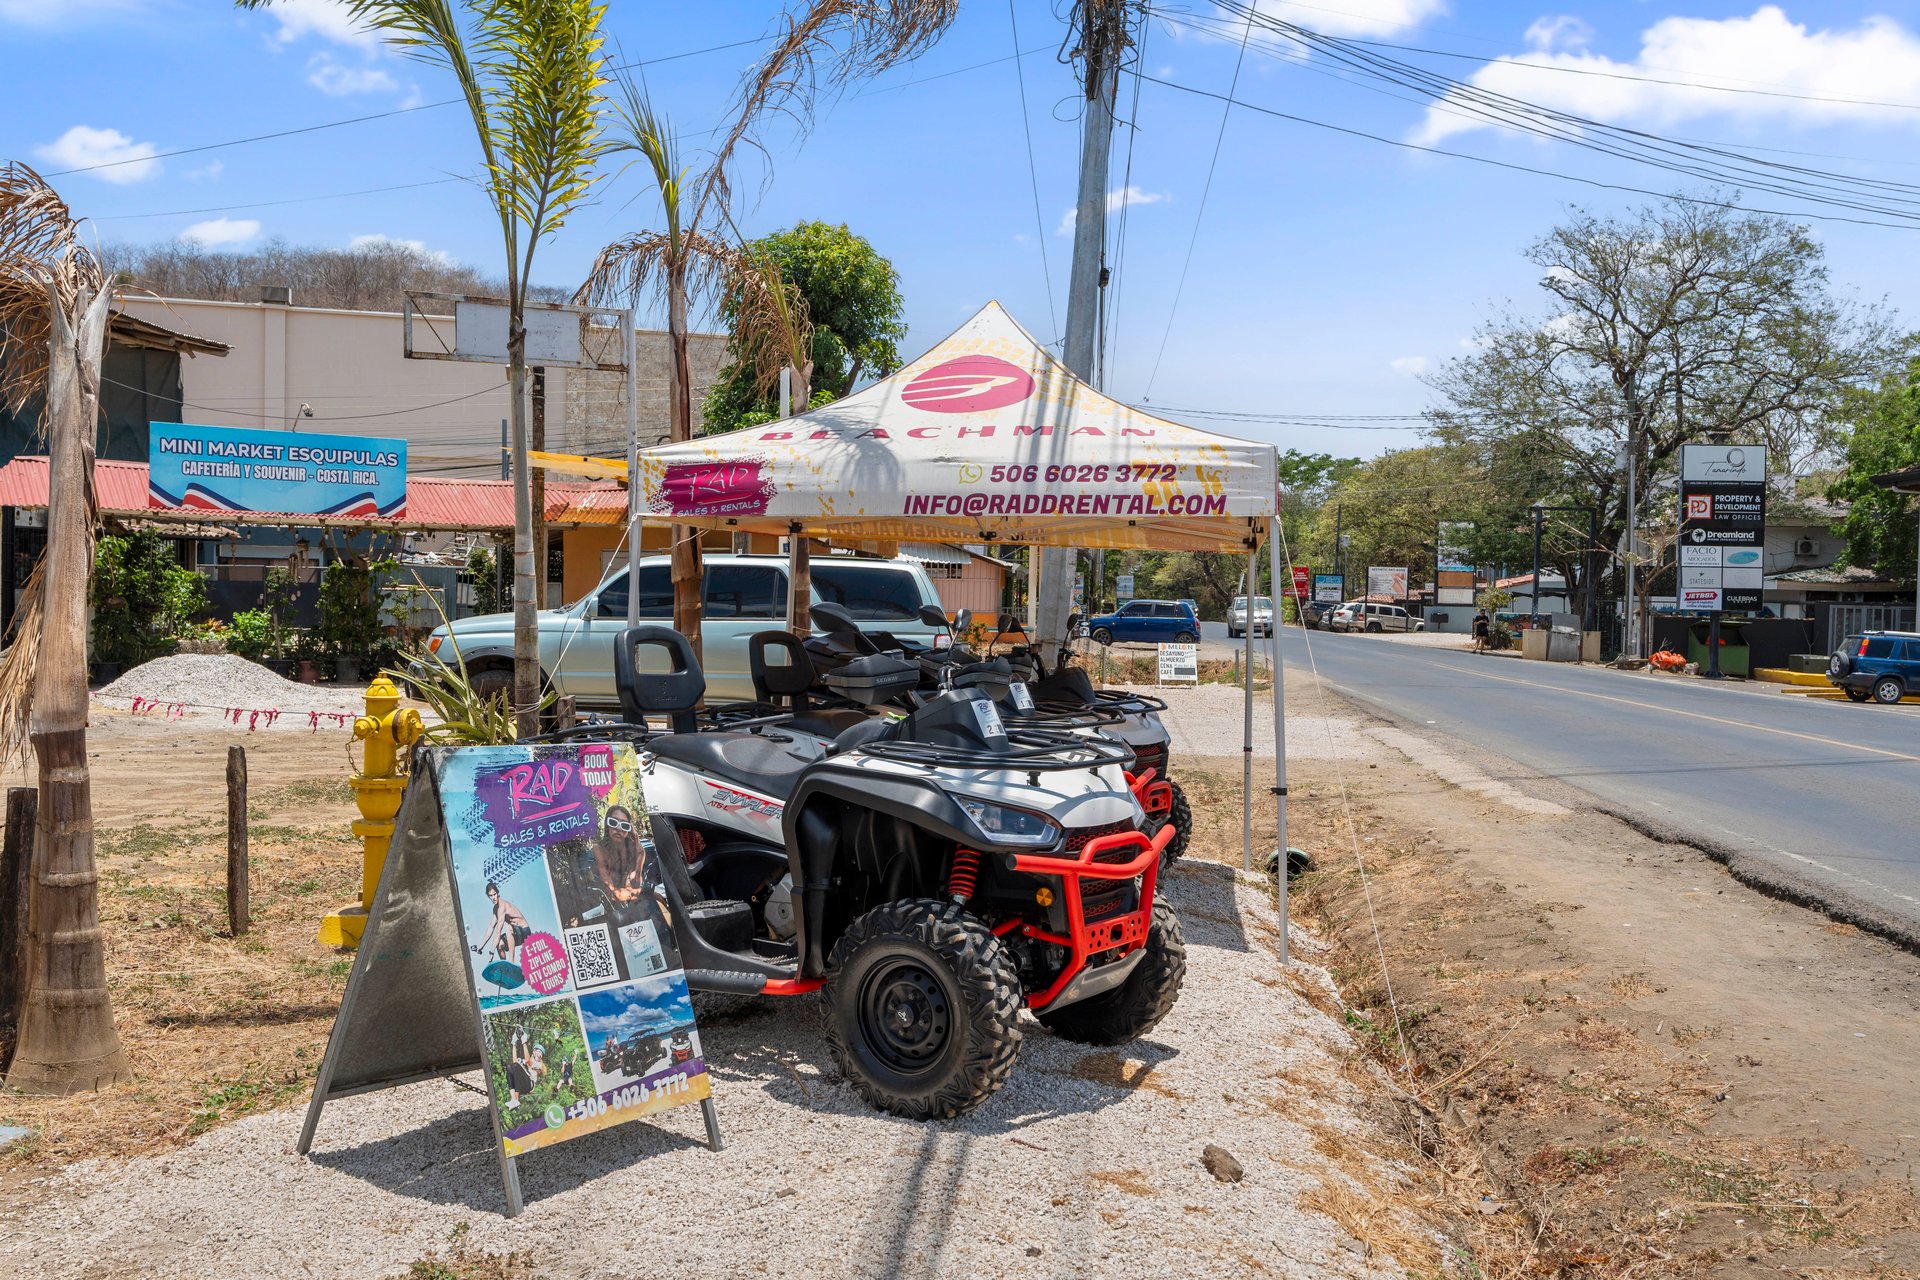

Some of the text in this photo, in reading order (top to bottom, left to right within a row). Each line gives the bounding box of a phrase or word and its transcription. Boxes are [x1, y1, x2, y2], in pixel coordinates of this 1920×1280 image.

[759, 425, 1155, 441] BEACHMAN
[160, 437, 399, 467] MINI MARKET ESQUIPULAS
[182, 460, 240, 478] CAFETERÍA
[243, 464, 251, 478] Y
[254, 465, 306, 482] SOUVENIR
[316, 468, 349, 484] COSTA
[352, 471, 379, 485] RICA.
[684, 463, 754, 501] RAD
[990, 464, 1177, 483] 506 6026 3772
[677, 499, 761, 517] SALES & RENTALS
[904, 493, 1228, 516] INFO@RADDRENTAL.COM
[1715, 495, 1753, 503] PROPERTY
[1686, 547, 1717, 555] FACIO
[876, 676, 898, 684] SEGWAY
[987, 725, 994, 734] 2
[584, 754, 608, 769] BOOK
[583, 770, 612, 786] TODAY
[500, 761, 573, 819] RAD
[500, 812, 590, 849] SALES & RENTALS
[626, 926, 644, 937] RAD
[525, 938, 548, 957] E-FOIL
[528, 949, 554, 970] ZIPLINE
[529, 958, 566, 985] ATV COMBO
[541, 973, 564, 991] TOURS
[568, 1072, 689, 1121] +506 6026 3772
